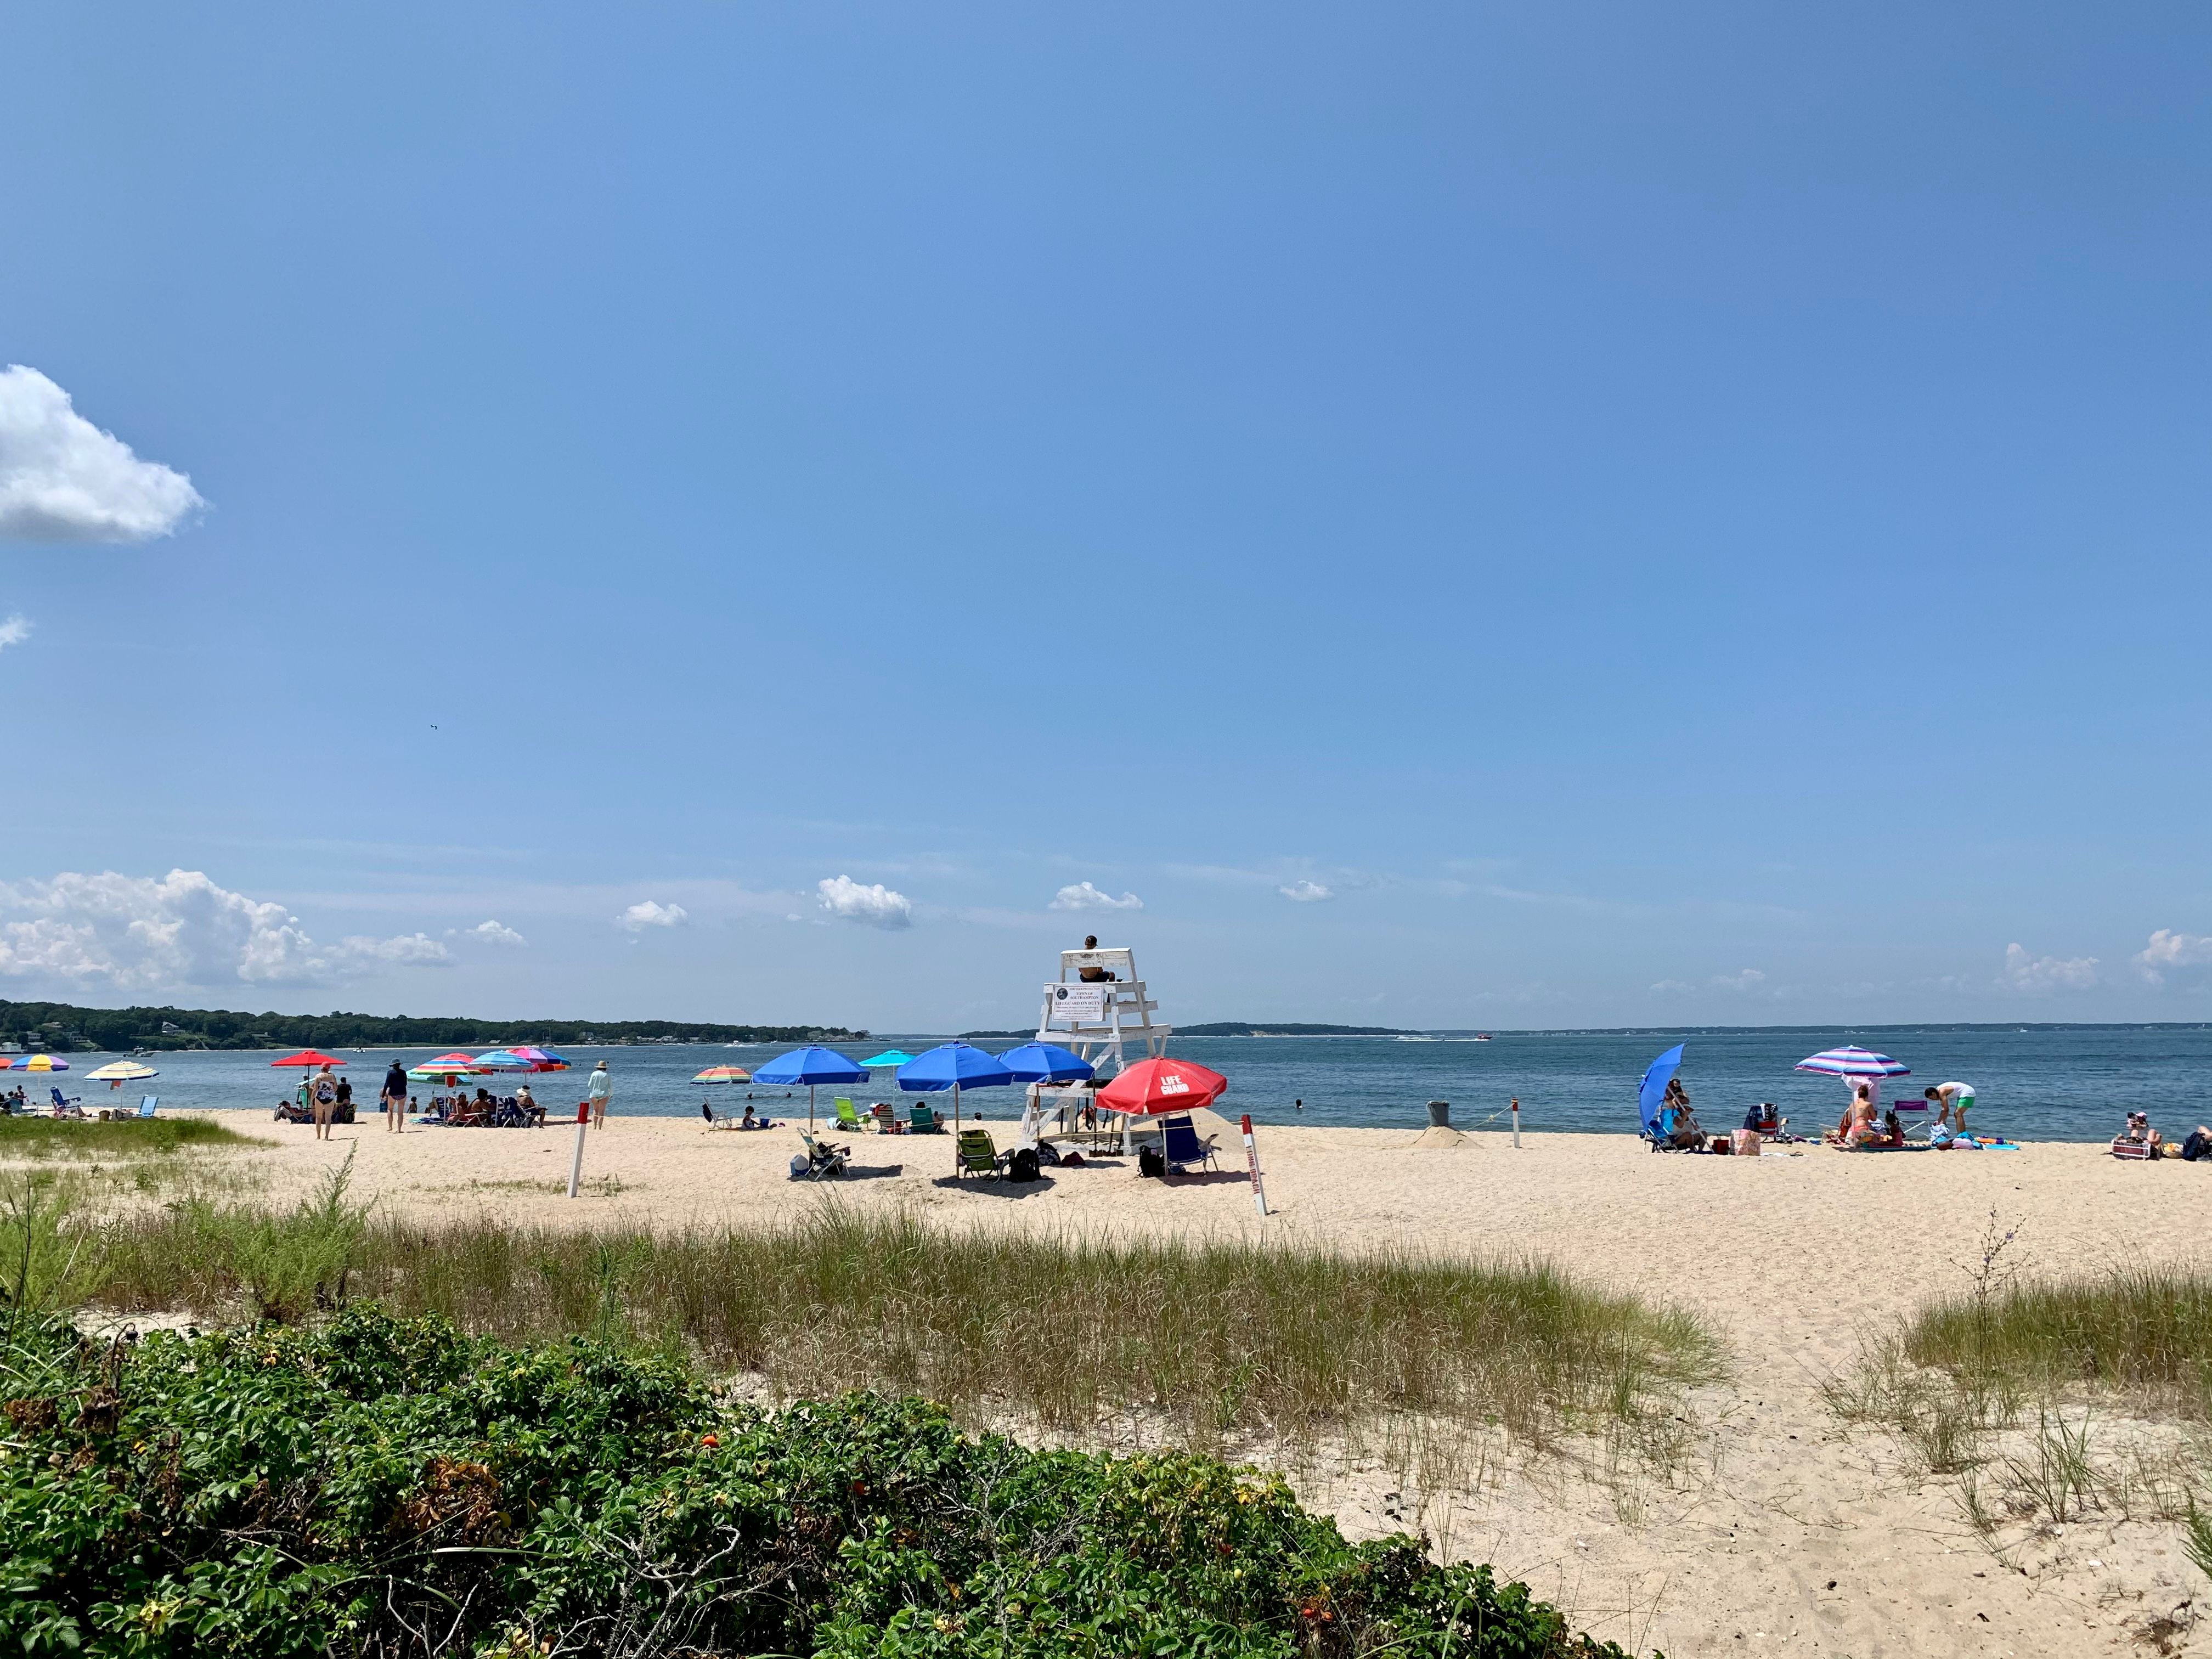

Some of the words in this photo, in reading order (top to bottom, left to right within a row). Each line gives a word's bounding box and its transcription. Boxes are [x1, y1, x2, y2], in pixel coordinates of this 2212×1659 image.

[1160, 1075, 1182, 1085] LIFE
[1160, 1084, 1189, 1095] GUARD
[1246, 1146, 1255, 1166] LONG
[1250, 1169, 1260, 1194] BEACH
